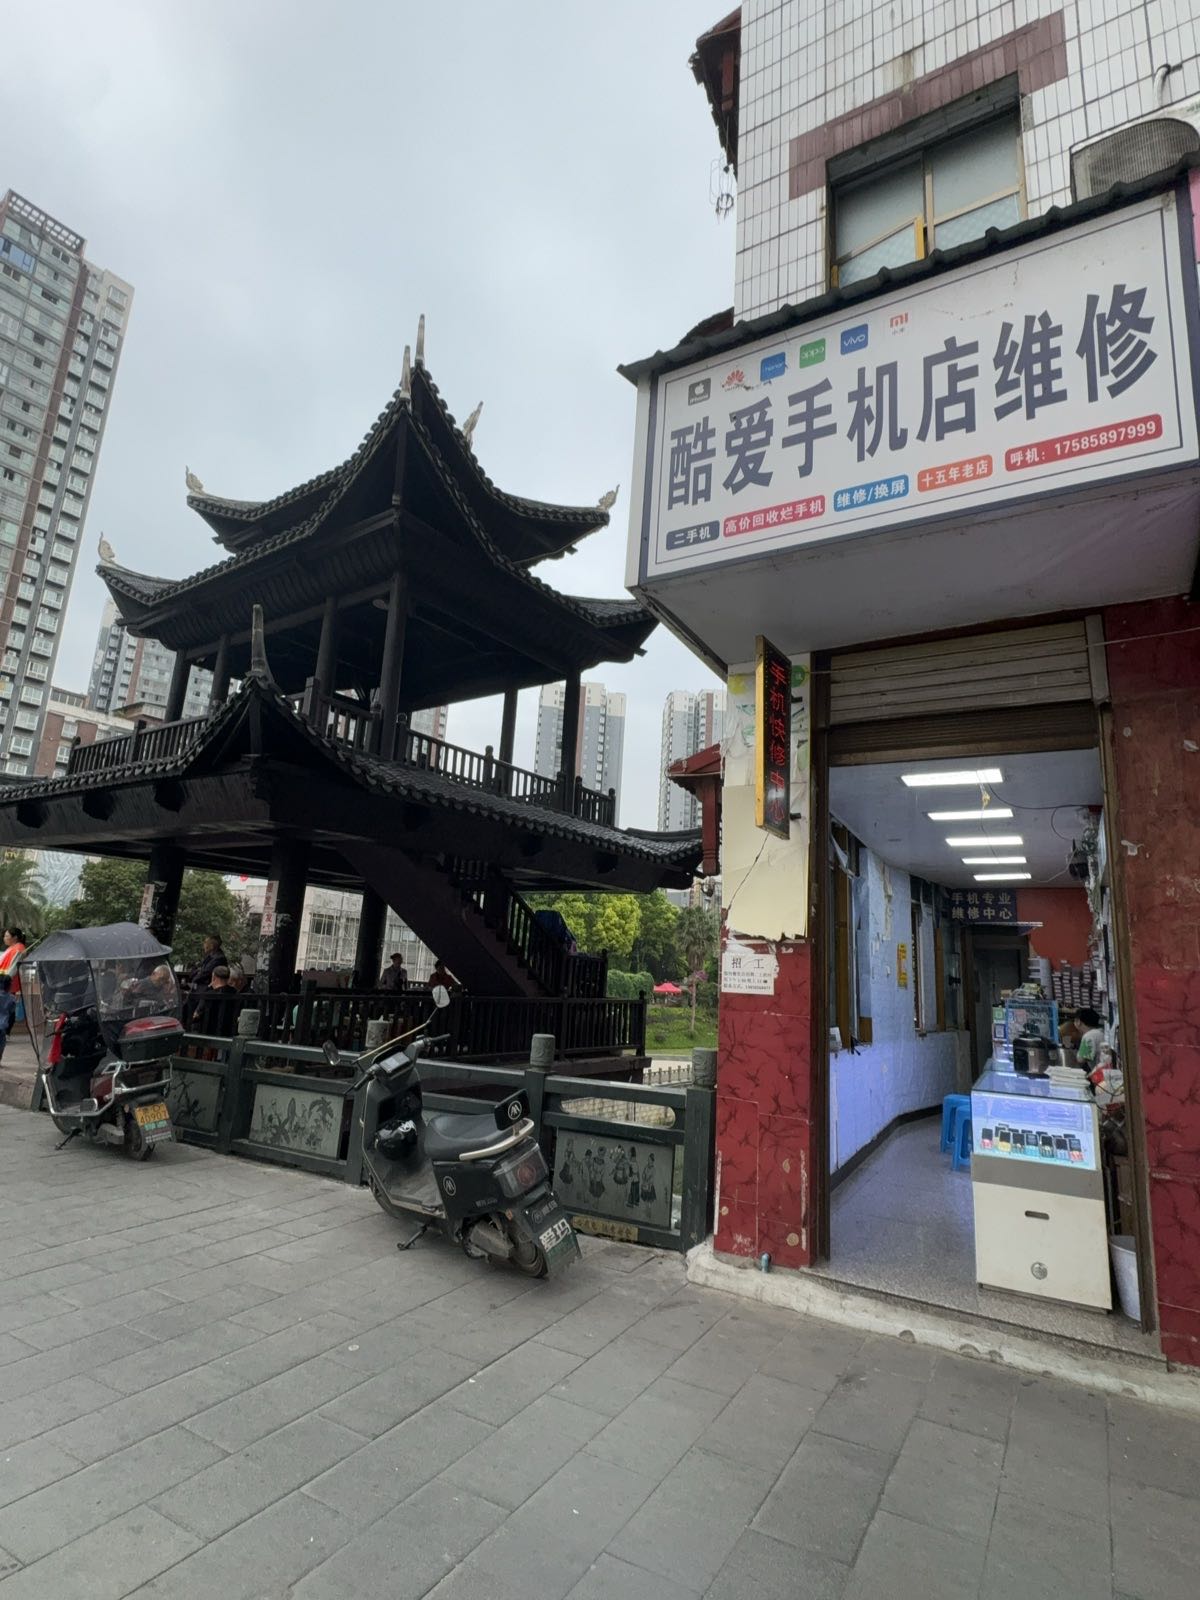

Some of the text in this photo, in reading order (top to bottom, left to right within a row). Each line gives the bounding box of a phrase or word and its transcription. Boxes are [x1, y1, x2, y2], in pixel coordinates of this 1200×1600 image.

[843, 334, 866, 347] vivo
[668, 284, 1158, 510] 酷爱手机店维修
[921, 460, 989, 488] 十五年老店
[837, 479, 906, 508] 维修/换屏
[725, 499, 824, 534] 高价回收烂手机
[674, 525, 712, 545] 二手机
[951, 892, 1012, 904] 手机专业
[951, 907, 1012, 919] 维修中心
[539, 1218, 572, 1252] 爱玛
